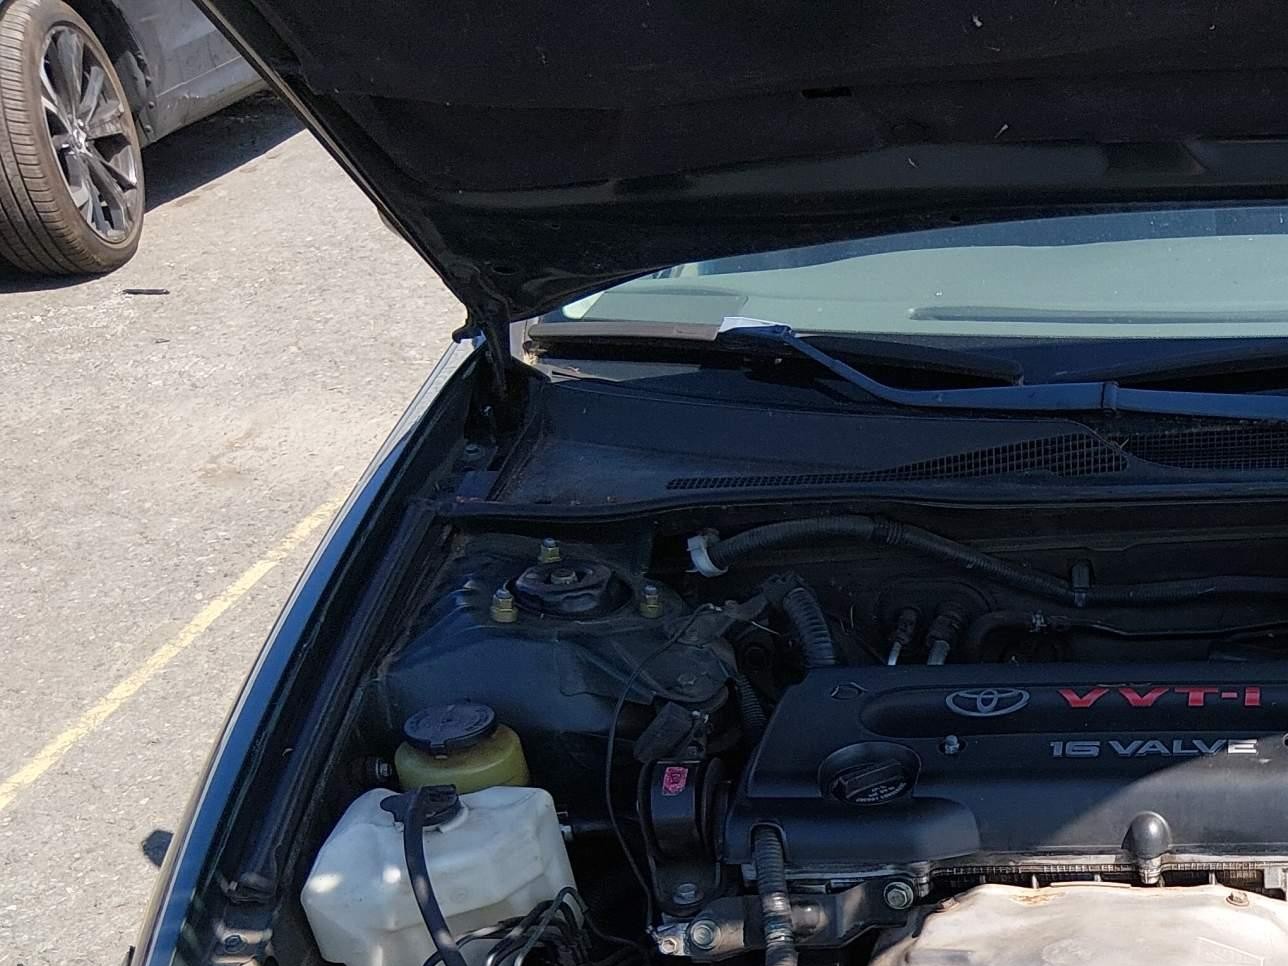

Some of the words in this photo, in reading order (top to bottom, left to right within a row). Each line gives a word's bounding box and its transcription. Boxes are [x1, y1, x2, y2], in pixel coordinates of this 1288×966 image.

[1058, 687, 1261, 708] VVT-I
[1050, 740, 1101, 758] 16
[1107, 739, 1258, 757] VALVE
